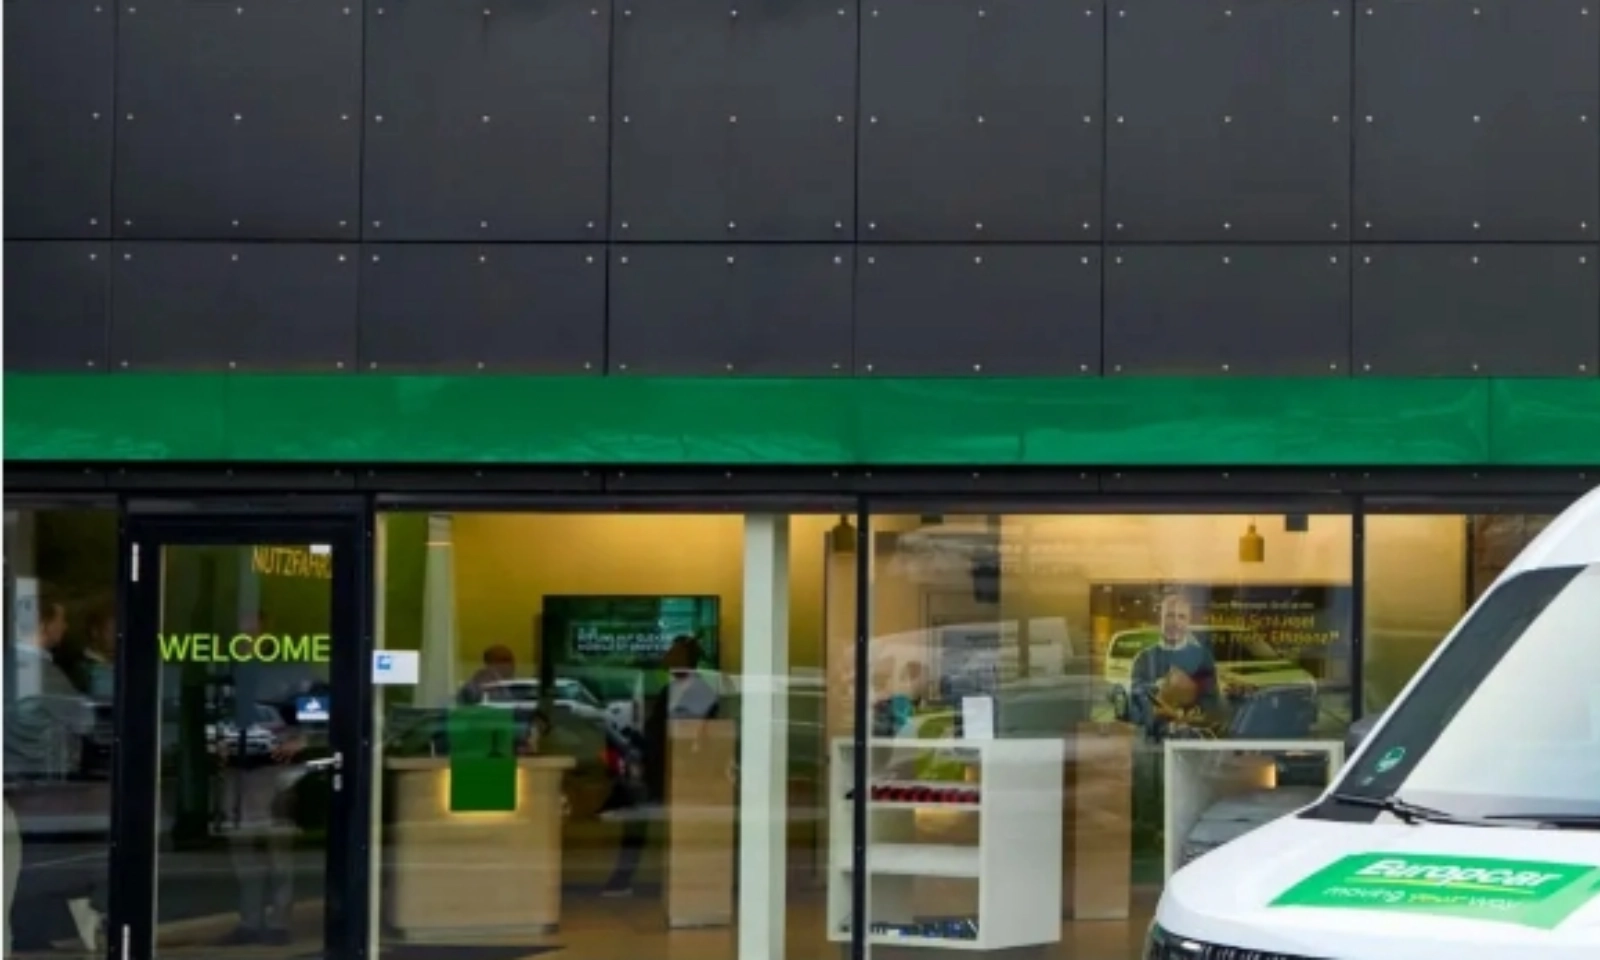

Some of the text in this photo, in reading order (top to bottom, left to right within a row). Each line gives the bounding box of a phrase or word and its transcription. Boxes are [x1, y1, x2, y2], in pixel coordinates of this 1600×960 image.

[158, 633, 331, 663] WELCOME
[1354, 859, 1564, 888] Europcar
[1322, 886, 1406, 903] moving
[1407, 892, 1468, 904] your
